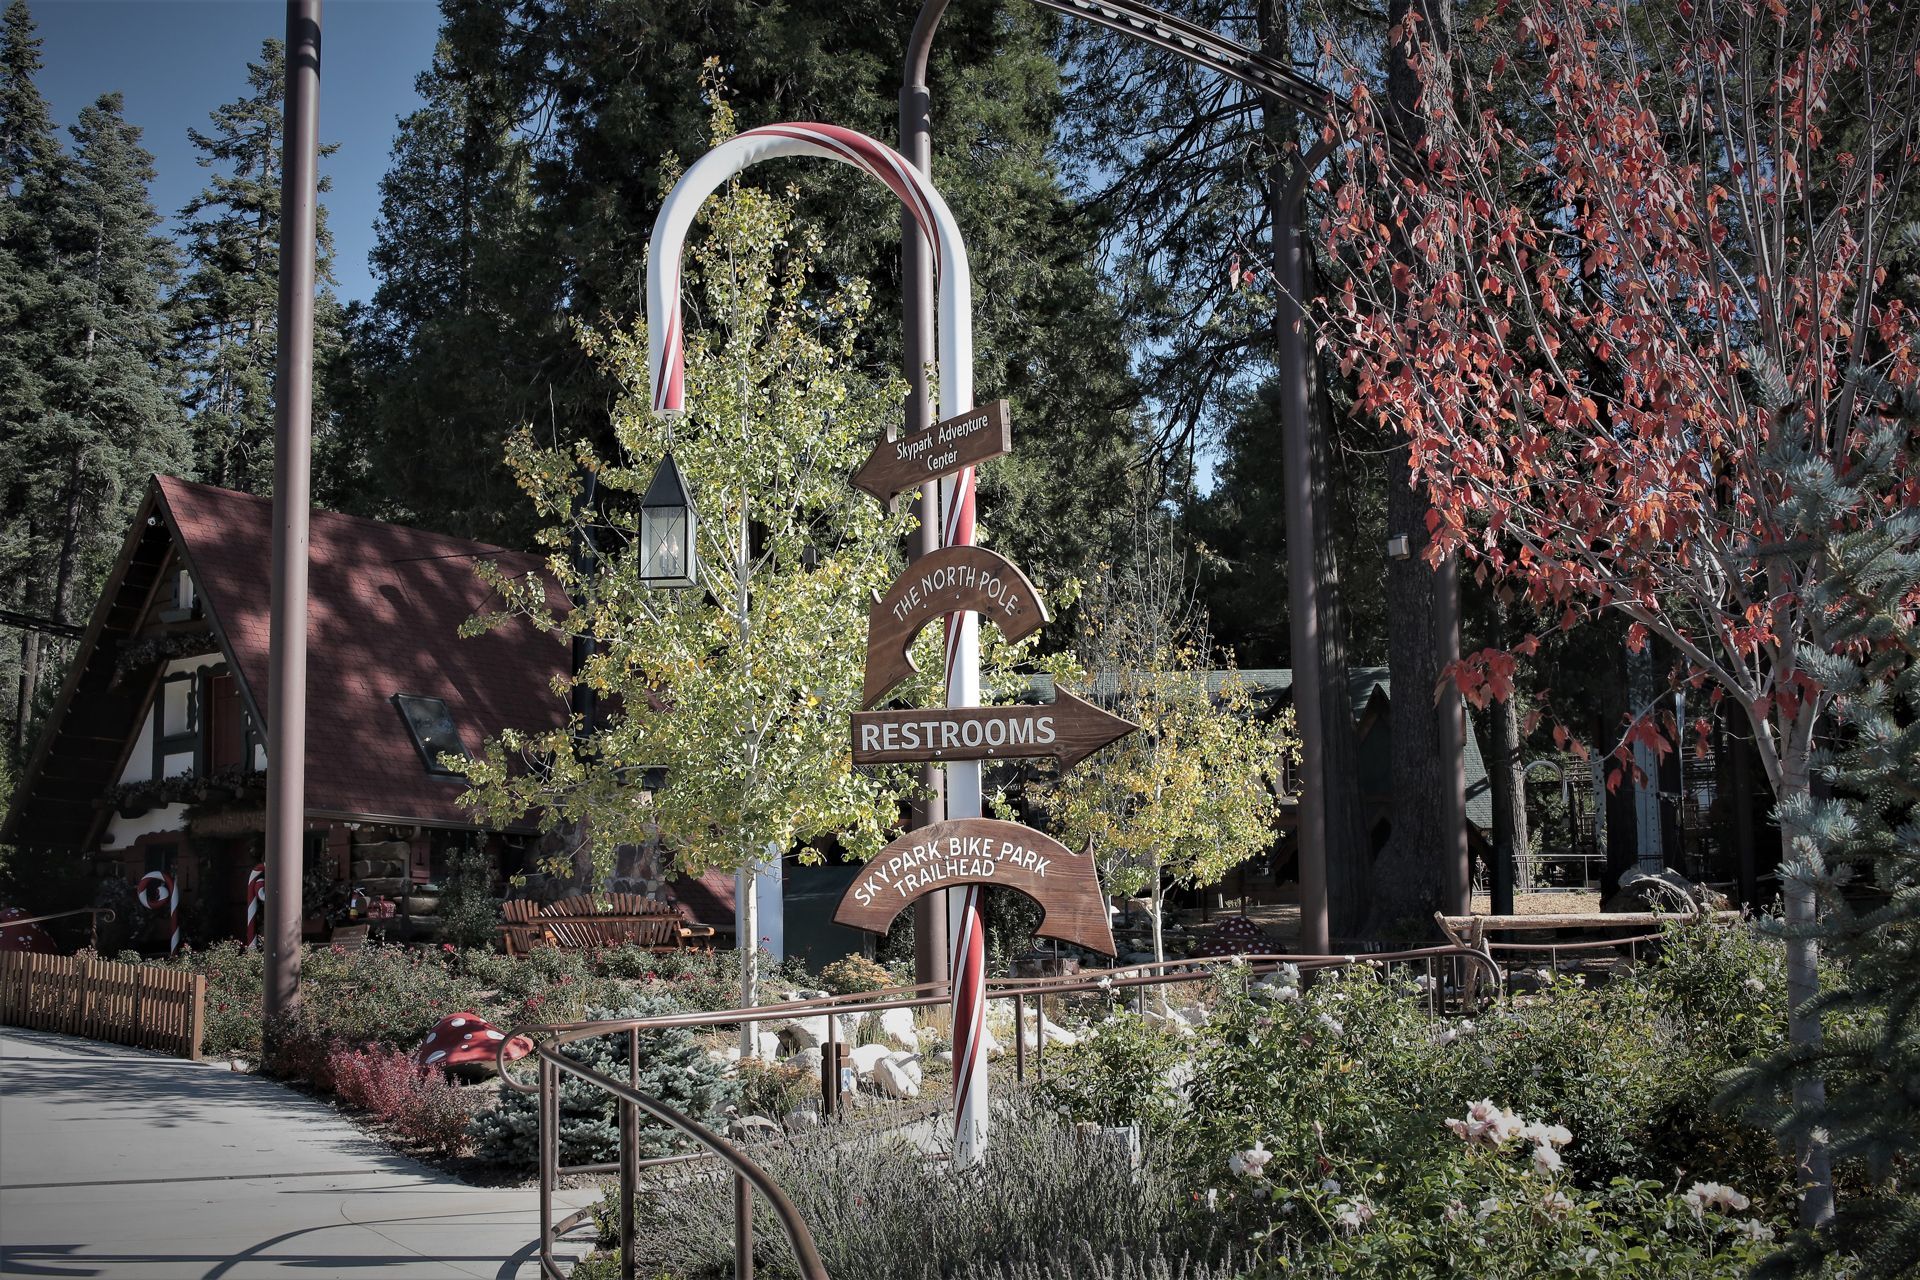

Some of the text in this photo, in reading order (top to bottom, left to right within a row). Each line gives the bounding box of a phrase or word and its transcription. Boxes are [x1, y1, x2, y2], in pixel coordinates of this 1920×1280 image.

[896, 414, 989, 461] Skypark Adventure
[927, 449, 958, 471] Center
[892, 565, 1019, 622] THE NORTH POLE
[861, 716, 1056, 751] RESTROOMS
[854, 836, 1051, 907] SKYPARK BIKE PARK
[893, 858, 995, 898] TRAILHEAD
